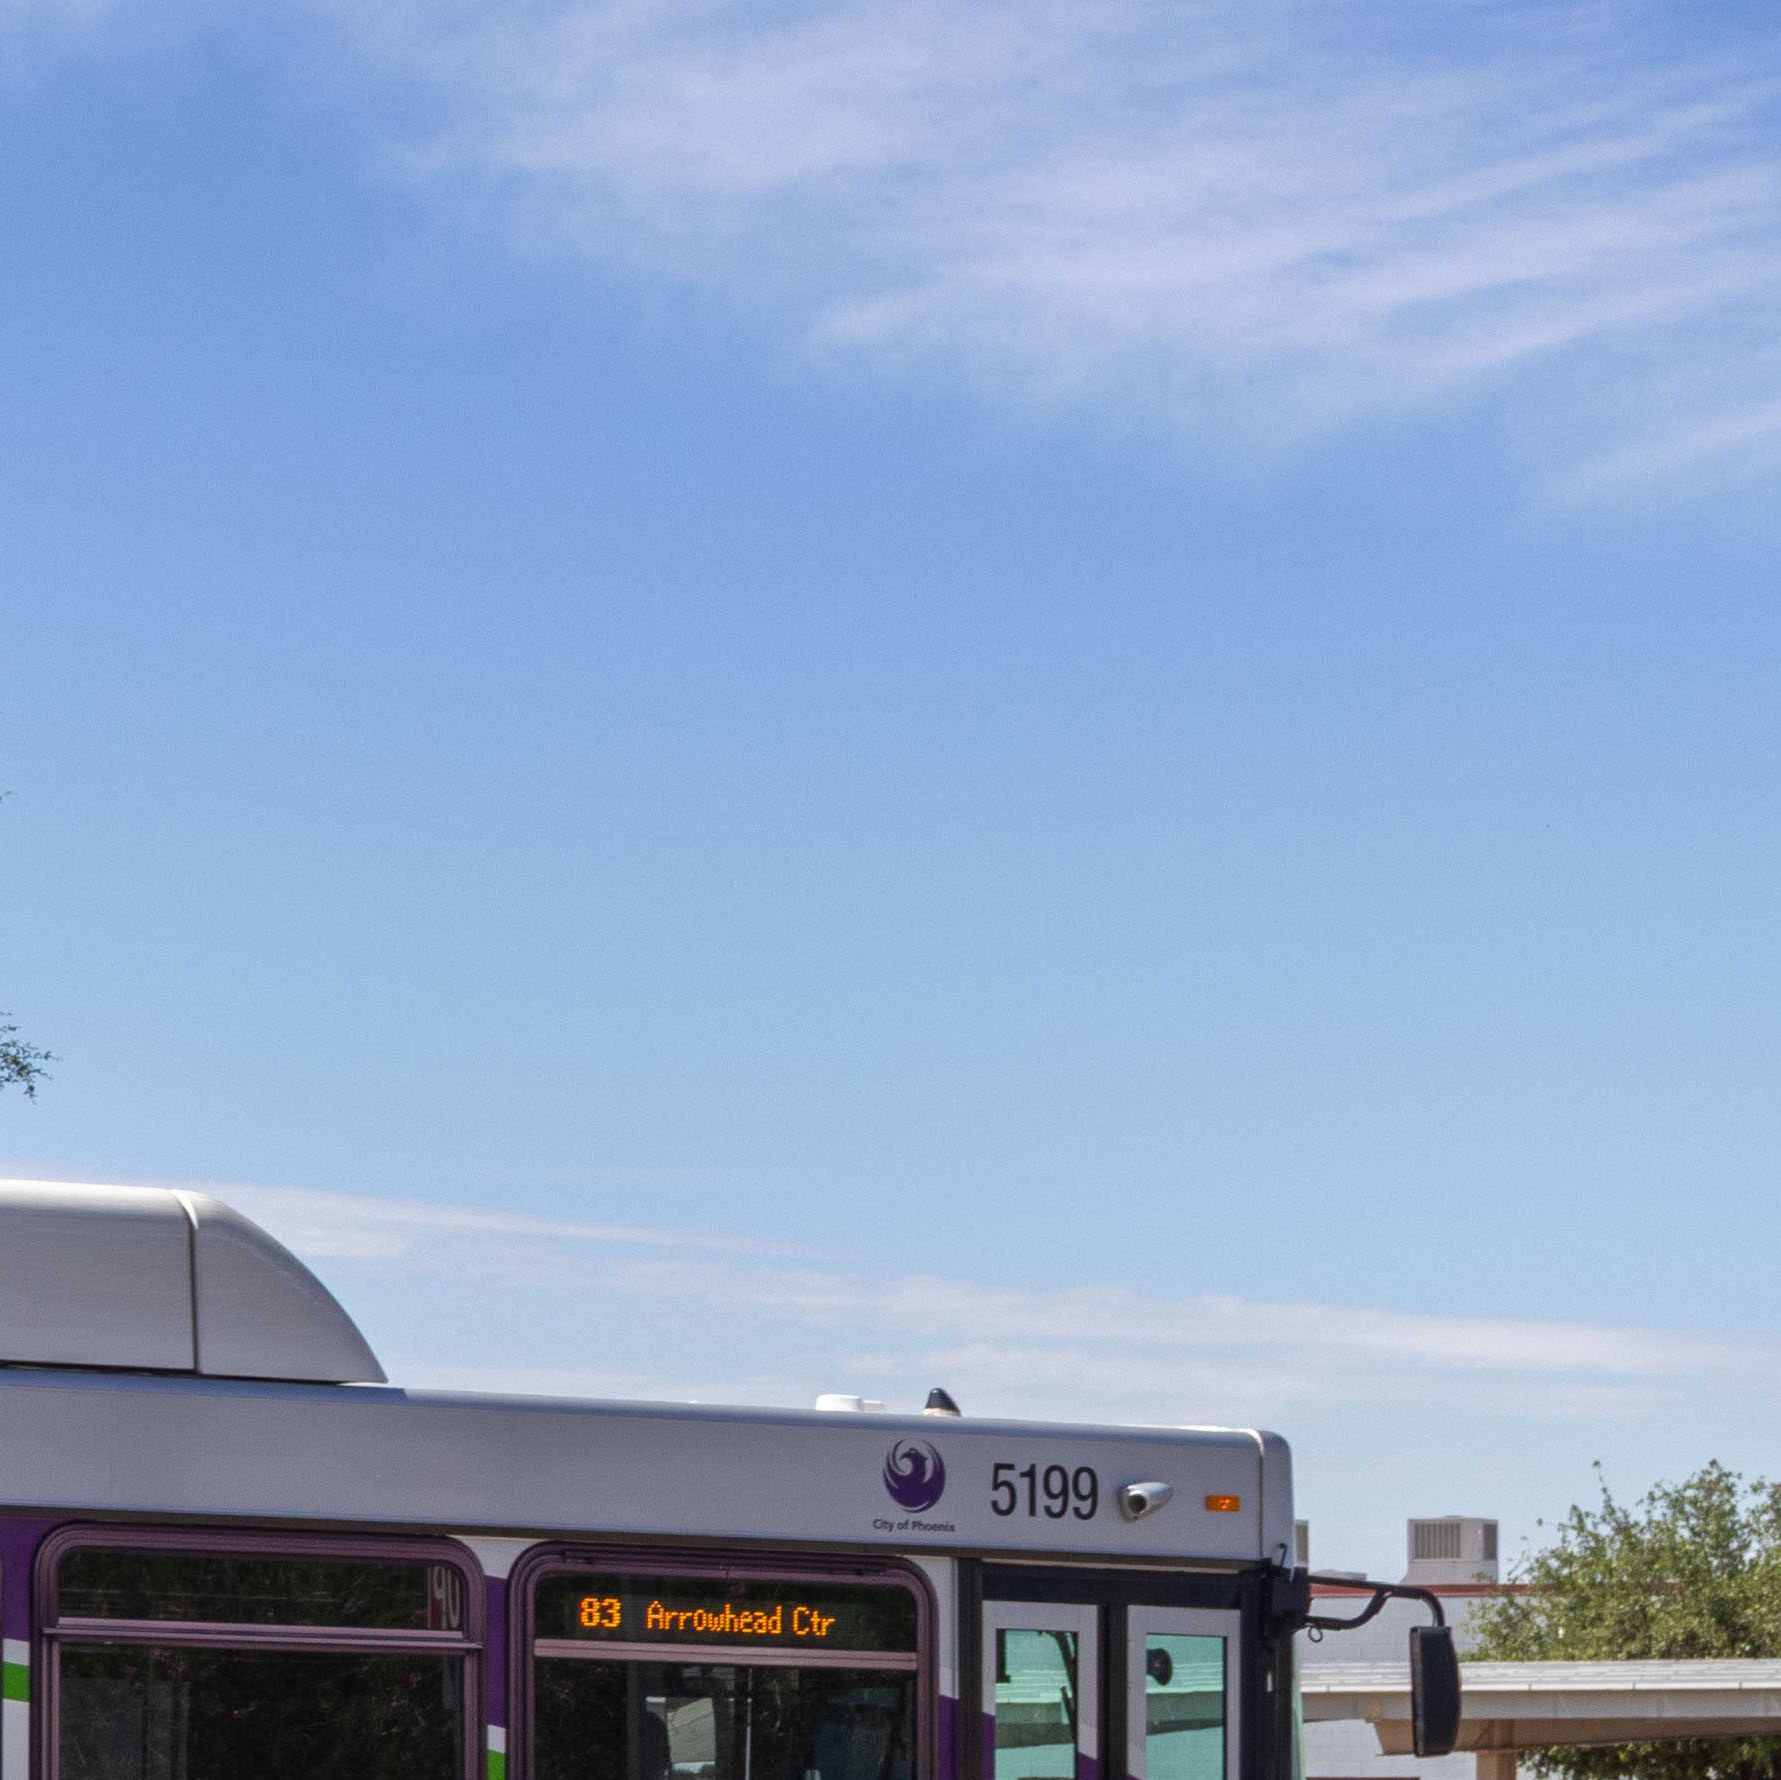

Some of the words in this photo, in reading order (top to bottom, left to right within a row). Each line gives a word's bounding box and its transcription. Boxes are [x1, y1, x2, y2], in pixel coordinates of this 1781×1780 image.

[991, 1462, 1099, 1520] 5199
[872, 1518, 894, 1533] City
[897, 1519, 909, 1531] of
[911, 1521, 956, 1533] Phoenix
[579, 1597, 622, 1628] 83
[646, 1600, 783, 1635] Arrowhead
[792, 1605, 836, 1637] Ctr
